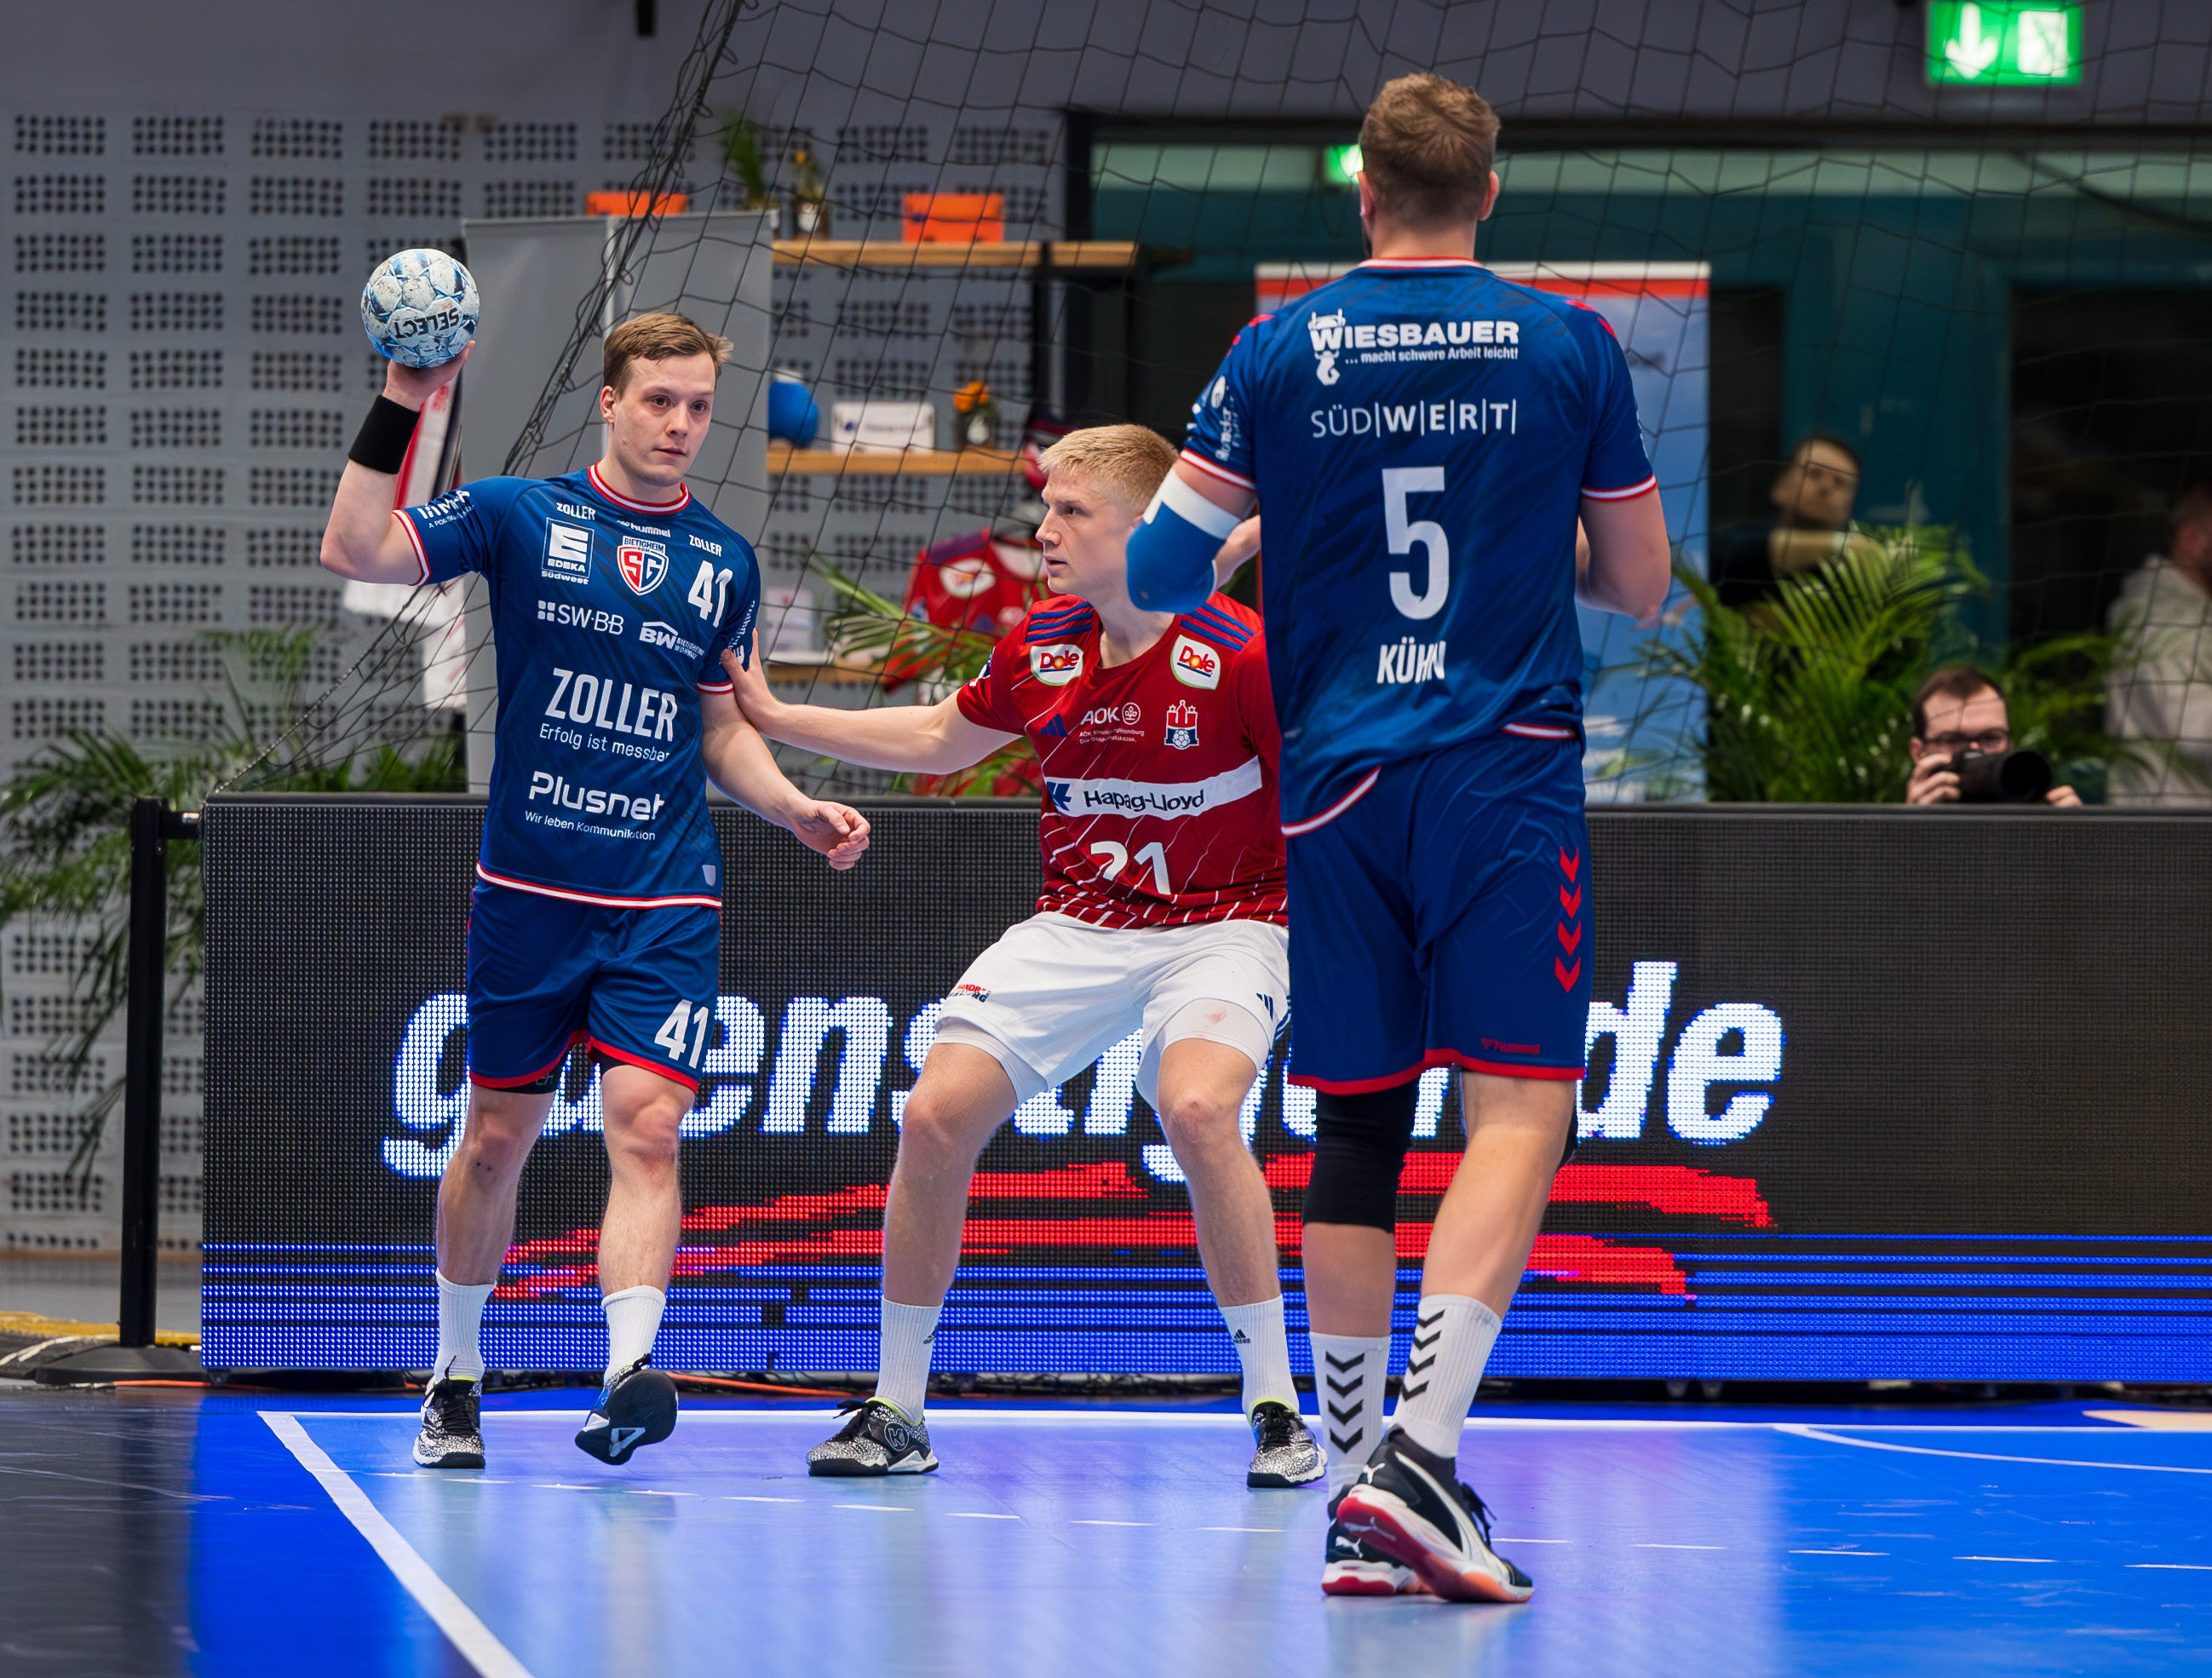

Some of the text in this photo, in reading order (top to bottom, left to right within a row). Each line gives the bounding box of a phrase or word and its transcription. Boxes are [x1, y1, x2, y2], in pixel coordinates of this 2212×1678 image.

[394, 307, 460, 339] SELECT
[1310, 320, 1520, 352] WIESBAUER
[1361, 349, 1396, 365] macht
[1399, 348, 1445, 362] schwere
[1448, 346, 1481, 360] Arbeit
[1484, 346, 1519, 360] leicht!
[556, 502, 596, 520] ZOLLER
[630, 522, 671, 538] hummel
[623, 537, 665, 554] BIETIGHEIM
[688, 534, 722, 558] ZOLLER
[1382, 466, 1450, 620] 5
[541, 570, 589, 585] Südwest
[547, 558, 586, 573] EDEKA
[687, 560, 733, 629] 41
[639, 627, 677, 649] BW
[1040, 650, 1080, 669] Dole
[1179, 645, 1215, 673] Dole
[1376, 636, 1447, 684] KÜHN
[545, 668, 678, 742] ZOLLER
[1080, 706, 1121, 726] AOK
[539, 723, 670, 761] Erfolg ist messbar
[529, 771, 665, 821] Plusnet
[1083, 789, 1204, 813] Hapag-Lloyd
[526, 811, 543, 824] Wir
[544, 814, 575, 830] leben
[653, 998, 710, 1070] 41
